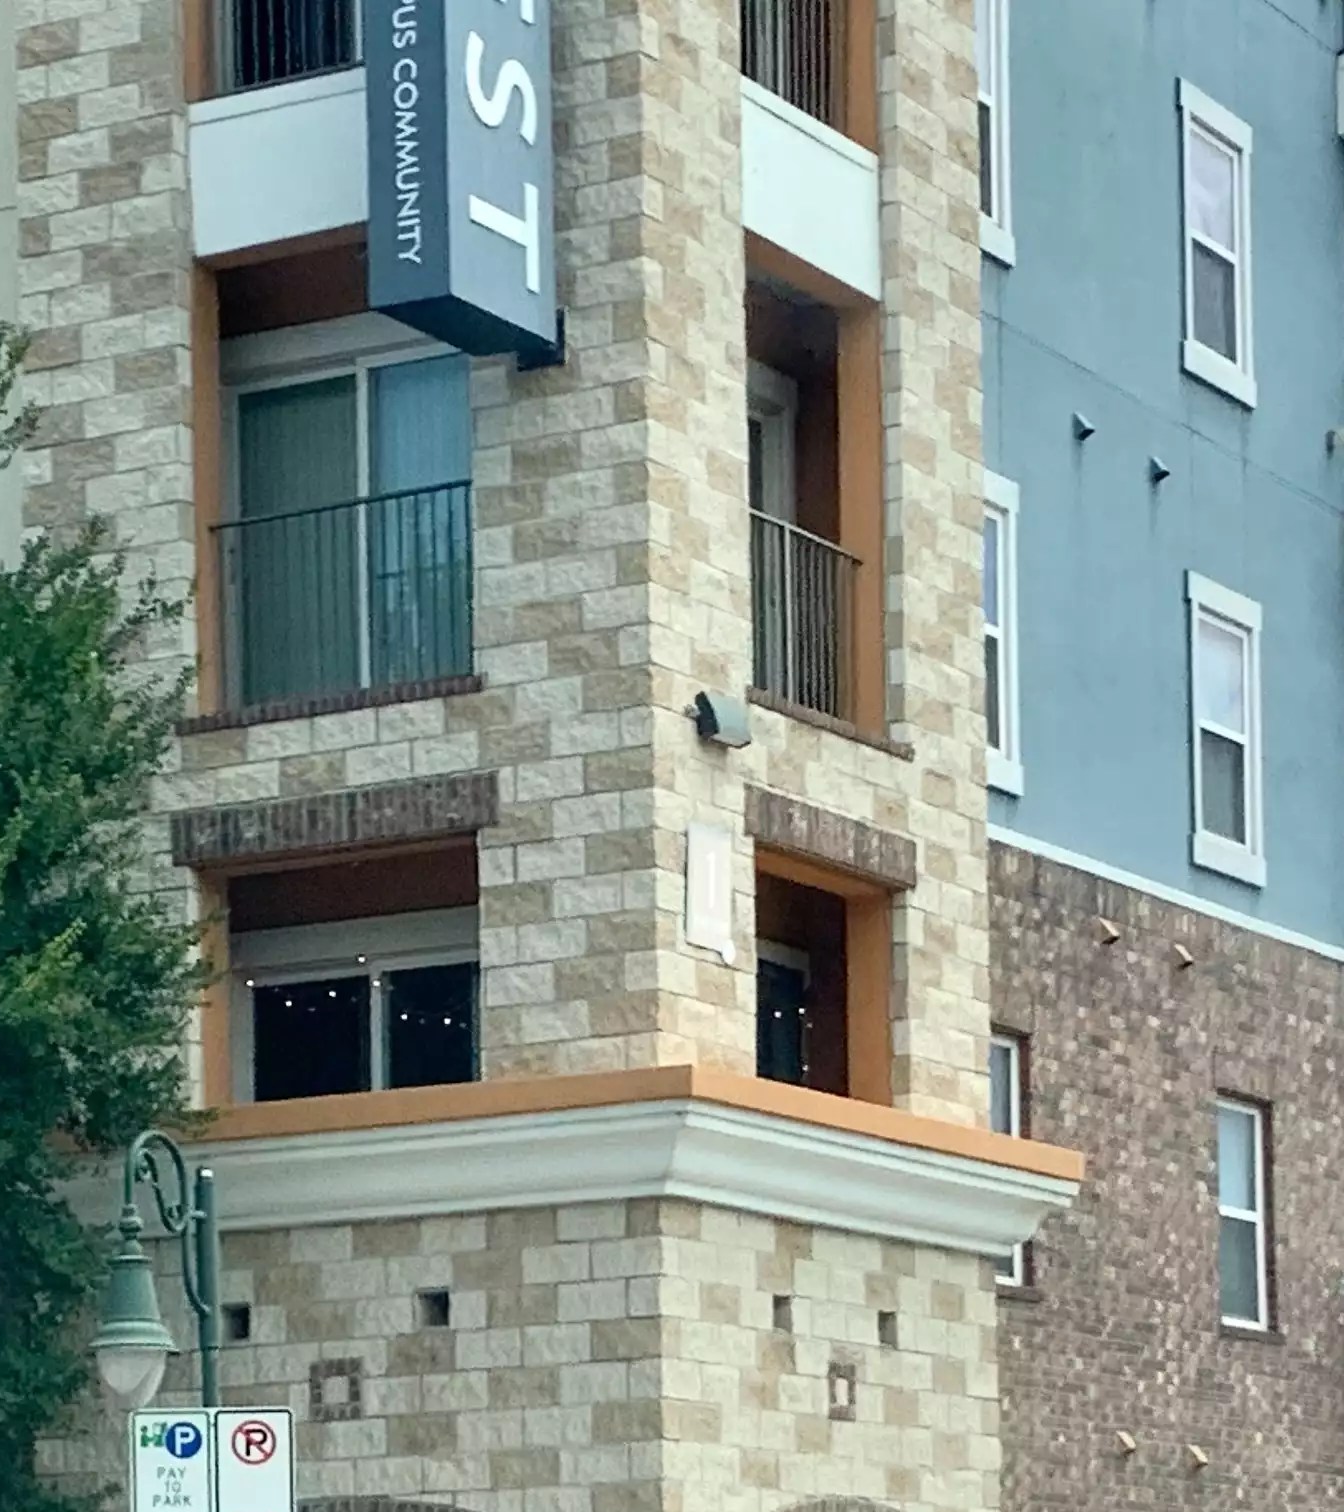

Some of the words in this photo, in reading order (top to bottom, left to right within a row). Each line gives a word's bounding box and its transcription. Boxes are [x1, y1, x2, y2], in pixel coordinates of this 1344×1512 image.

[392, 0, 417, 49] US
[393, 58, 423, 264] COMMUNITY
[465, 0, 541, 295] ST
[157, 1467, 187, 1480] PAY
[164, 1481, 182, 1493] TO
[152, 1495, 192, 1508] PARK
